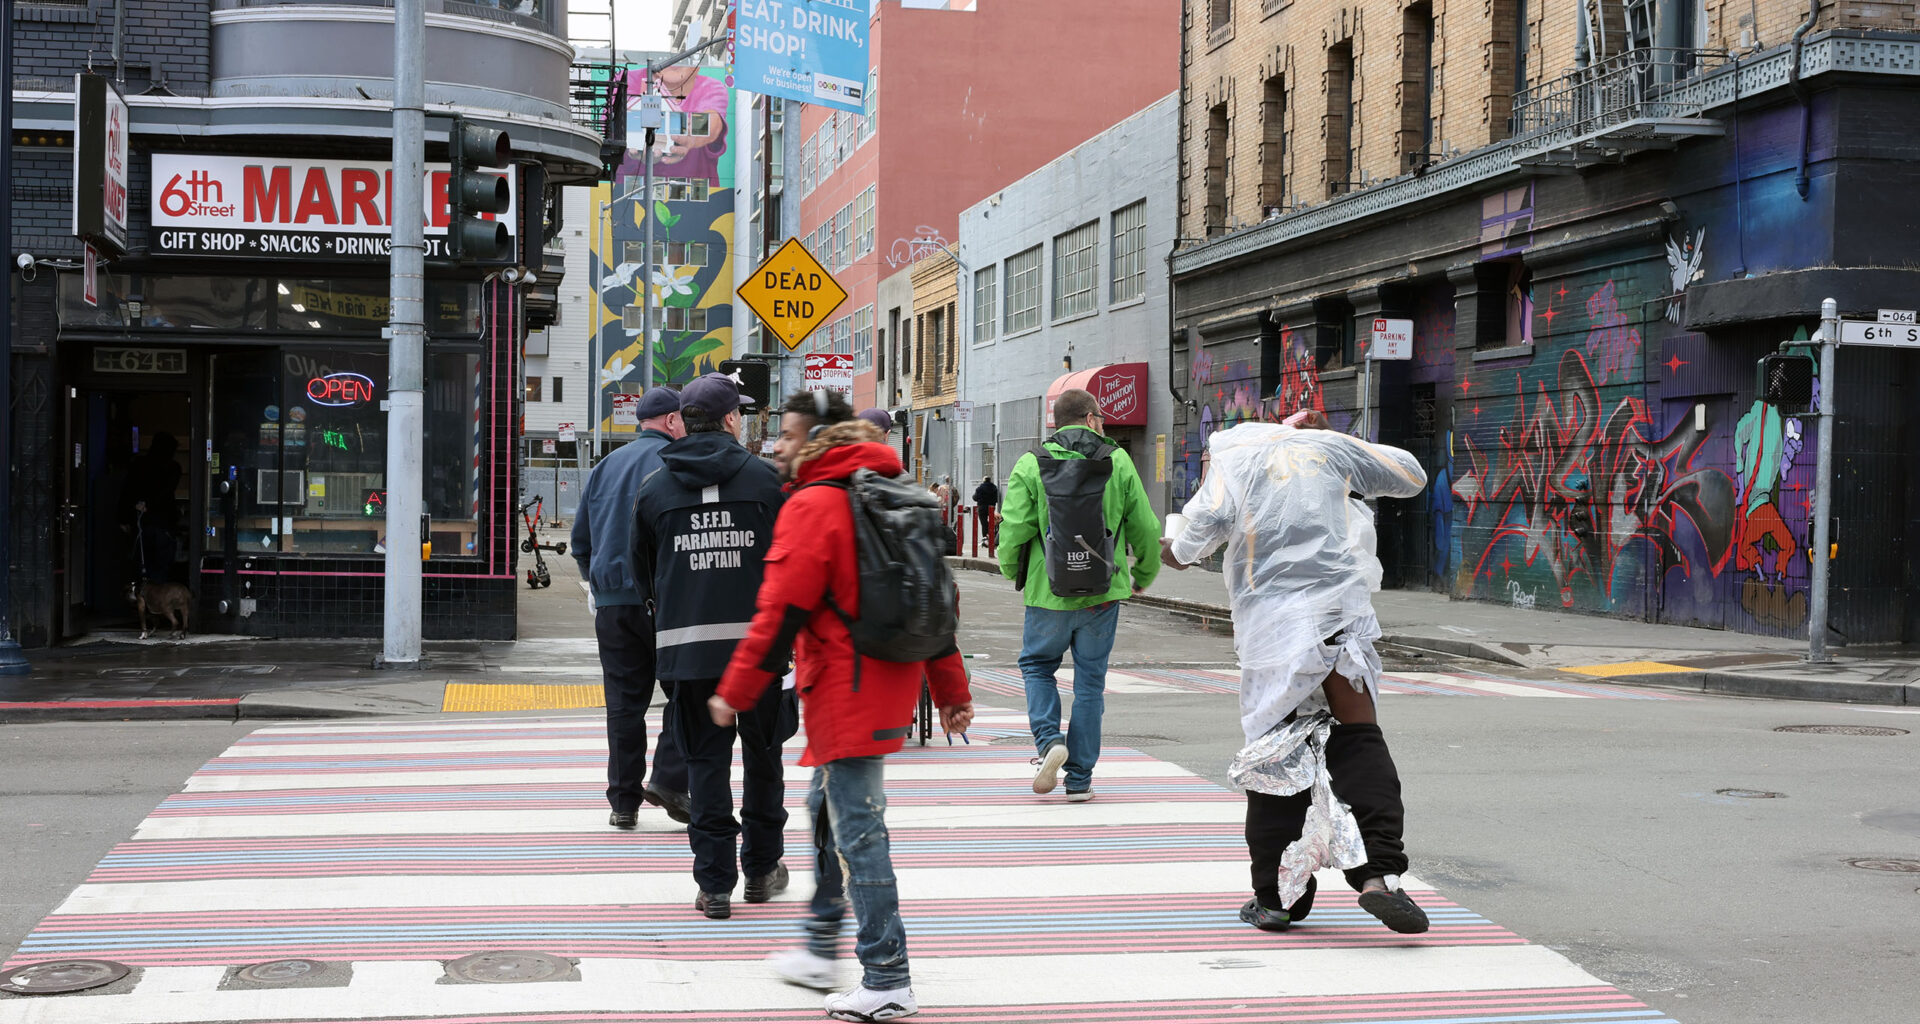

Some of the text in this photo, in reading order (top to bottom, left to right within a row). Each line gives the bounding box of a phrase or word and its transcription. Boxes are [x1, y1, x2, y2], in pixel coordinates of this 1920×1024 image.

[741, 0, 863, 48] EAT, DRINK,
[739, 24, 806, 59] SHOP!
[768, 64, 812, 83] We're open
[763, 74, 776, 85] for
[776, 76, 812, 93] business!
[159, 165, 509, 228] 6th MARE
[188, 201, 236, 217] Street
[160, 231, 197, 250] GIFT
[201, 232, 245, 251] SHOP
[260, 234, 320, 254] SNACKS
[765, 271, 822, 291] DEAD
[774, 300, 814, 318] END
[1892, 312, 1913, 322] 064
[1376, 321, 1385, 330] NO
[1864, 327, 1892, 340] 6th
[1380, 333, 1406, 342] PARKING
[806, 369, 852, 379] NO STOPPING
[307, 377, 372, 402] OPEN
[1100, 381, 1133, 408] SALVATION
[1105, 378, 1121, 392] THE
[1112, 394, 1133, 414] ARMY
[690, 511, 735, 530] S.F.F.D.
[674, 530, 755, 552] PARAMEDIC
[689, 550, 741, 571] CAPTAIN
[1067, 551, 1089, 560] HOT
